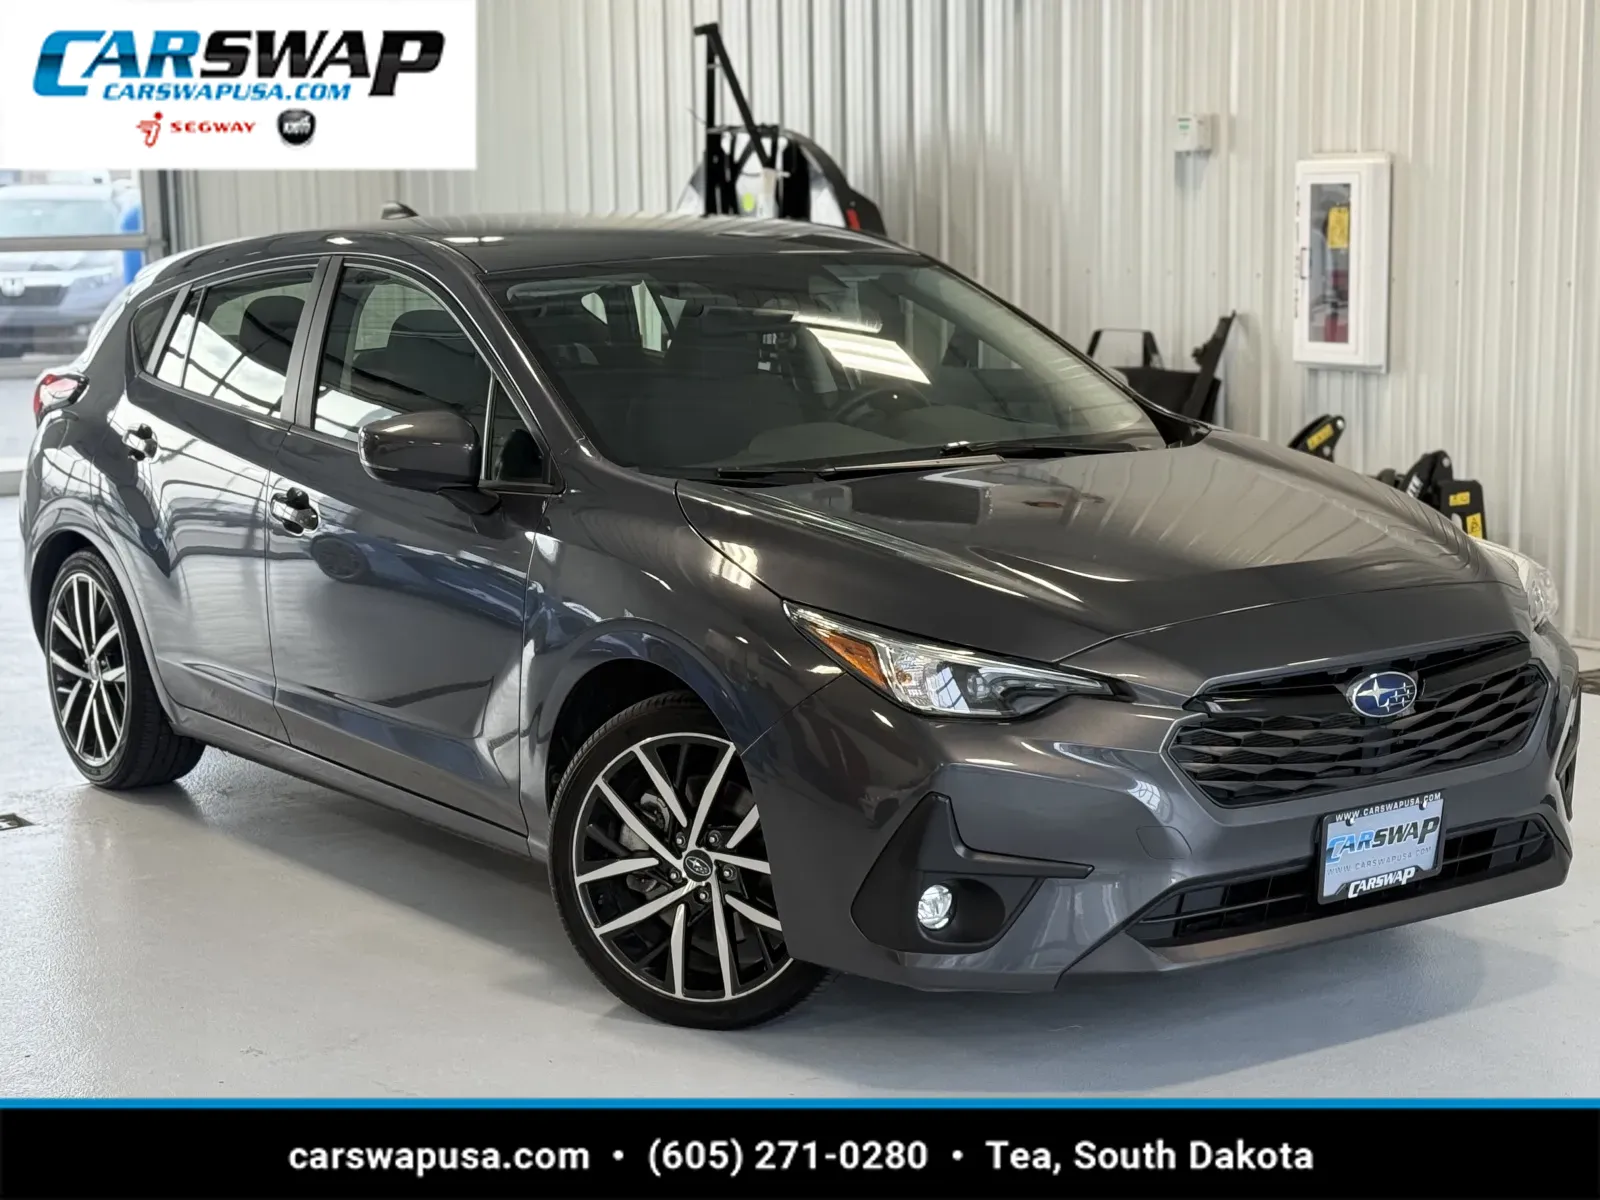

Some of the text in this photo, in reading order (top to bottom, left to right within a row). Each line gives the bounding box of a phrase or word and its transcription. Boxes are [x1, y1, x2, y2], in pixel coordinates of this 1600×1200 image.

[1335, 792, 1441, 821] WWW.CARSWAPUSA.COM
[1326, 816, 1440, 864] CARSWAP
[1327, 846, 1432, 876] WWWCARSWAPUSACOM
[1348, 867, 1415, 898] CARSWAP
